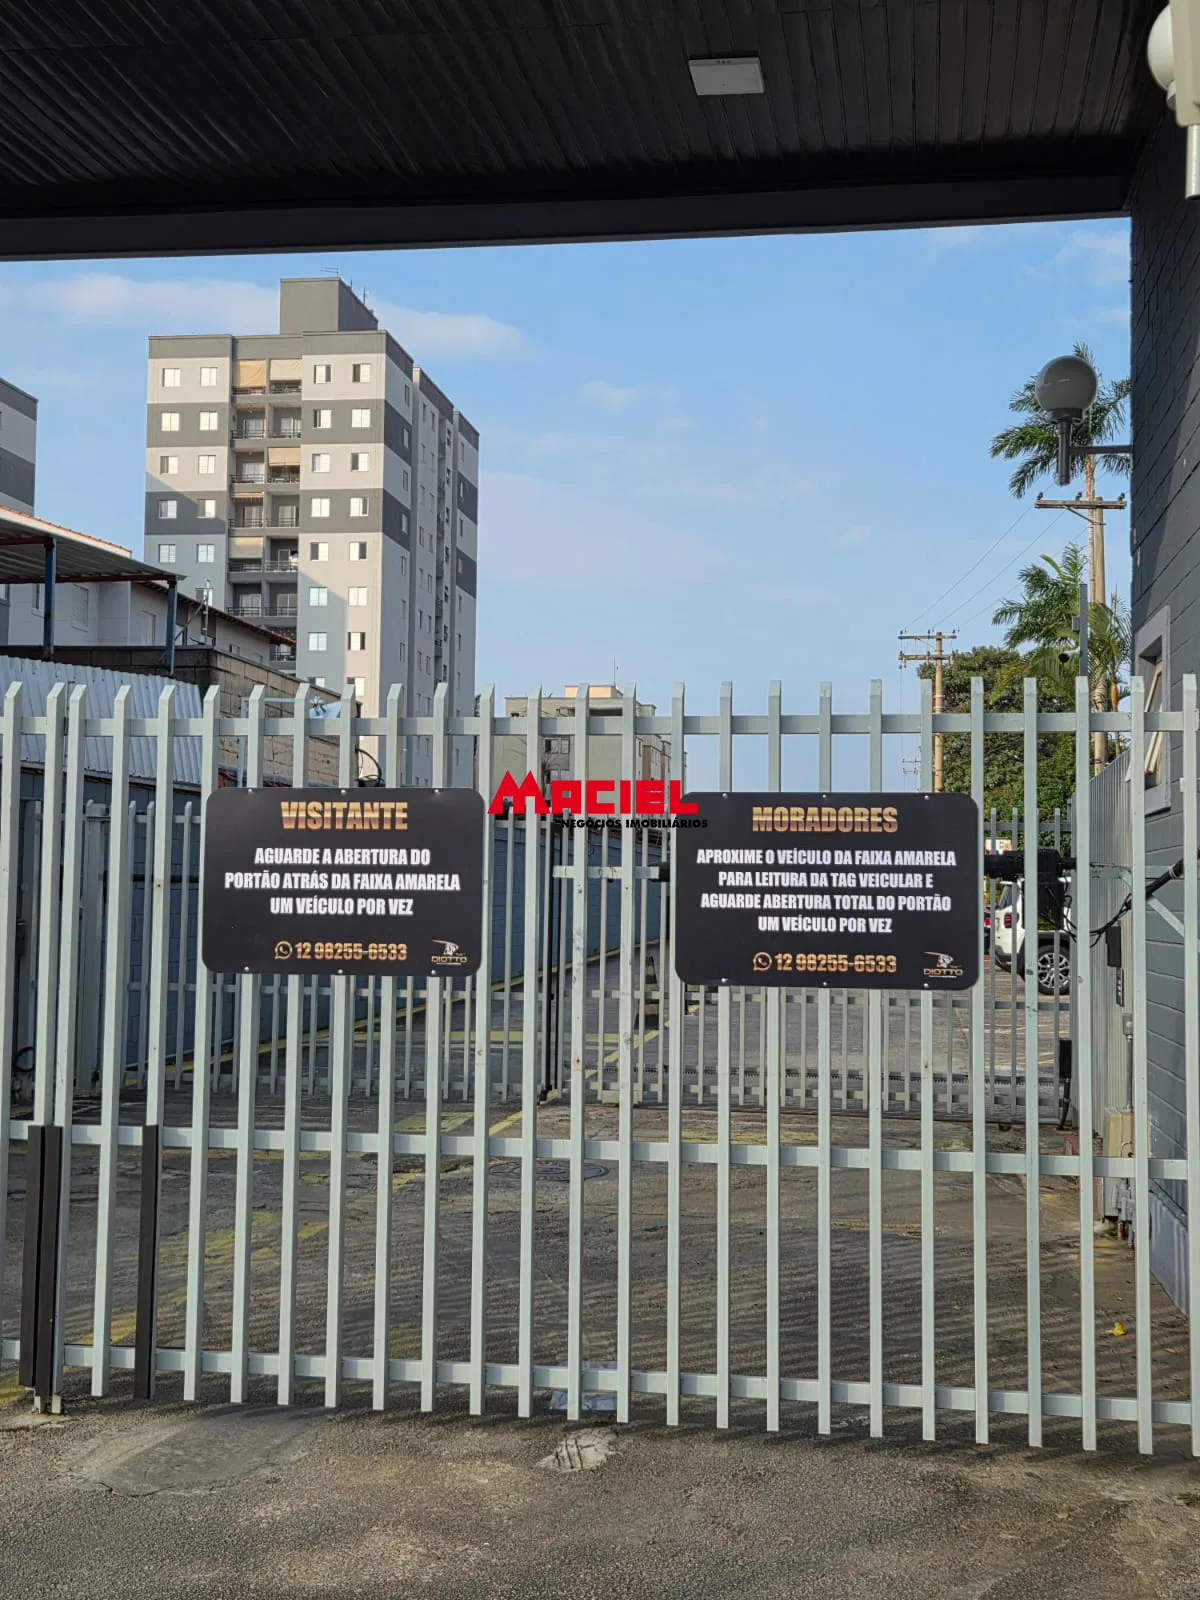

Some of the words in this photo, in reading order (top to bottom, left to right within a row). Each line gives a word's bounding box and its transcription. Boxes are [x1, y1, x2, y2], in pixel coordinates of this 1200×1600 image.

[280, 801, 409, 831] VISITANTE
[752, 806, 898, 833] MORADORES
[254, 848, 321, 866] AGUARDE
[322, 849, 333, 866] A
[334, 849, 409, 867] ABERTURA
[410, 850, 432, 867] DO
[696, 848, 764, 866] APROXIME
[765, 850, 776, 866] O
[777, 848, 833, 867] VEÍCULO
[834, 851, 854, 867] DA
[855, 851, 893, 867] FAIXA
[894, 851, 958, 867] AMARELA
[225, 870, 281, 890] PORTÃO
[282, 871, 329, 890] ATRÁS
[331, 874, 352, 891] DA
[353, 874, 394, 891] FAIXA
[395, 874, 462, 892] AMARELA
[718, 871, 754, 887] PARA
[755, 872, 808, 888] LEITURA
[810, 873, 829, 889] DA
[830, 873, 857, 889] TAG
[858, 873, 924, 889] VEICULAR
[925, 874, 934, 889] E
[270, 897, 294, 915] UM
[295, 895, 355, 916] VEÍCULO
[357, 898, 387, 916] POR
[388, 899, 414, 917] VEZ
[700, 893, 762, 910] AGUARDE
[763, 894, 833, 911] ABERTURA
[834, 895, 875, 911] TOTAL
[876, 895, 896, 911] DO
[897, 893, 952, 912] PORTÃO
[758, 916, 780, 932] UM
[781, 914, 837, 933] VEÍCULO
[839, 917, 867, 933] POR
[868, 918, 893, 934] VEZ
[295, 942, 312, 960] 12
[314, 943, 408, 961] 98255-6533
[775, 953, 793, 971] 12
[796, 953, 897, 973] 98255-6533
